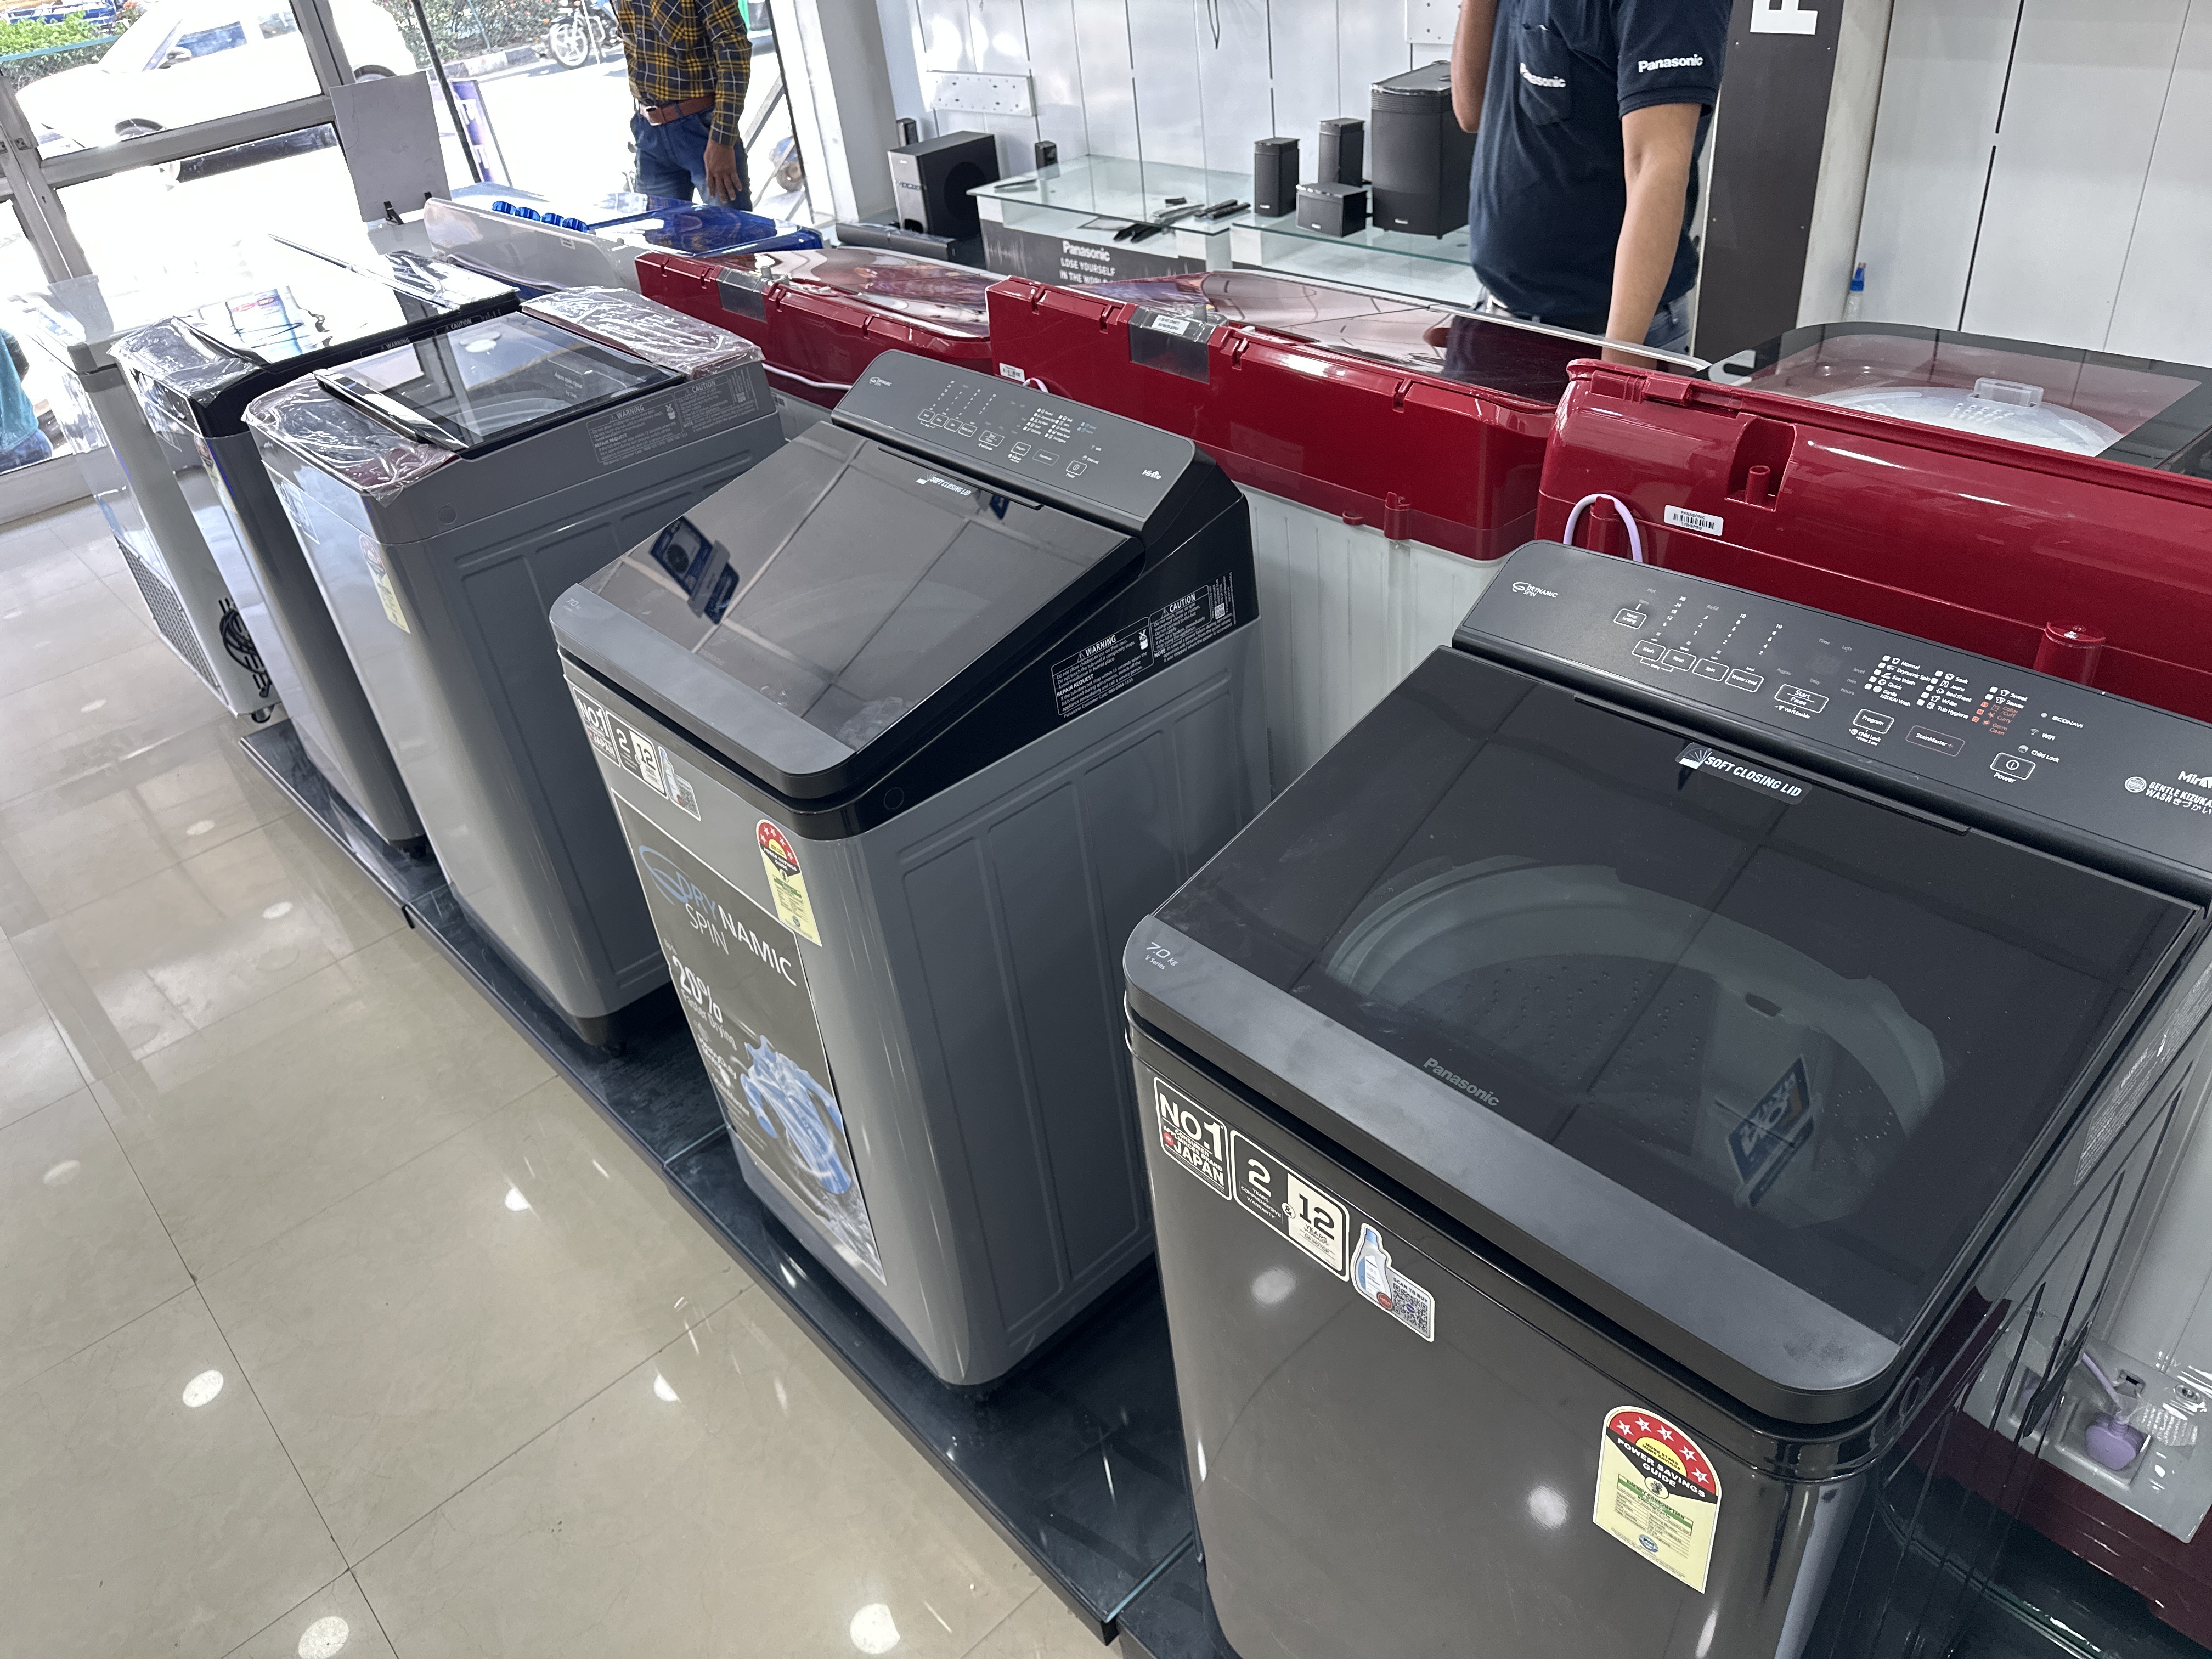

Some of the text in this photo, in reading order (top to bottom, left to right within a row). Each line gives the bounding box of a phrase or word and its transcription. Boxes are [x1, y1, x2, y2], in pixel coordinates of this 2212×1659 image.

[1638, 54, 1703, 73] Panasonic
[1063, 240, 1110, 262] Panasonic
[1060, 257, 1115, 276] LOSE YOURSELF
[1059, 269, 1068, 279] IN
[1068, 271, 1083, 283] THE
[451, 319, 472, 329] CAUTION
[386, 338, 410, 349] WARNING
[692, 380, 716, 393] CAUTION
[616, 404, 644, 419] WARNING
[930, 477, 944, 485] SOFT
[941, 481, 963, 493] CLOSING
[1526, 585, 1558, 598] DRYNAMIC
[1170, 593, 1195, 612] CAUTION
[1085, 635, 1116, 657] WARNING
[1154, 649, 1165, 658] NOTE
[1897, 668, 1920, 679] Drynamic
[1901, 661, 1921, 670] Normal
[1057, 674, 1093, 697] REPAIR REQUEST
[1888, 682, 1902, 691] Quick
[1901, 678, 1916, 686] Wash
[1790, 697, 1807, 706] Pause
[1795, 690, 1811, 699] Start
[1942, 698, 1957, 707] White
[1956, 694, 1972, 703] Sheet
[2010, 693, 2028, 702] Sweat
[2006, 700, 2024, 709] Sauces
[578, 699, 609, 737] NO.1
[1862, 715, 1884, 726] Program
[1947, 708, 1969, 719] Hygiene
[1997, 715, 2012, 724] Curry
[593, 735, 614, 756] JAPAN
[616, 729, 631, 754] 2
[1916, 733, 1948, 746] StainMaster
[637, 743, 656, 771] 12
[2030, 750, 2046, 758] Child
[1705, 756, 1802, 797] SOFT CLOSING LID
[1994, 773, 2016, 783] Power
[2146, 788, 2172, 803] WASH
[2149, 782, 2181, 797] GENTLE
[764, 847, 778, 860] POWER
[778, 856, 797, 871] SAVINGS
[686, 903, 729, 955] SPIN
[1146, 942, 1178, 966] 7.0 kg
[1150, 958, 1166, 969] Series
[672, 955, 723, 1023] 20%
[681, 989, 707, 1021] Faster
[1423, 1057, 1499, 1106] Panasonic
[1164, 1125, 1199, 1155] APPLIANCES
[1201, 1154, 1223, 1172] BRAND
[1175, 1129, 1209, 1158] CONSUMER
[1173, 1141, 1224, 1186] JAPAN
[1248, 1159, 1271, 1197] 2
[1241, 1186, 1281, 1217] COMPREHENSIVE
[1252, 1188, 1269, 1203] YEARS
[1247, 1196, 1276, 1218] WARRANTY
[1285, 1205, 1292, 1217] &
[1299, 1193, 1334, 1241] 12
[1305, 1224, 1328, 1240] YEARS
[1393, 1277, 1408, 1289] SCAN
[1418, 1293, 1427, 1303] BUY
[1642, 1444, 1680, 1471] MORE SAVINGS
[1645, 1443, 1678, 1465] MORE STARS
[1618, 1438, 1706, 1498] POWER SAVINGS
[1643, 1463, 1677, 1487] GUIDE
